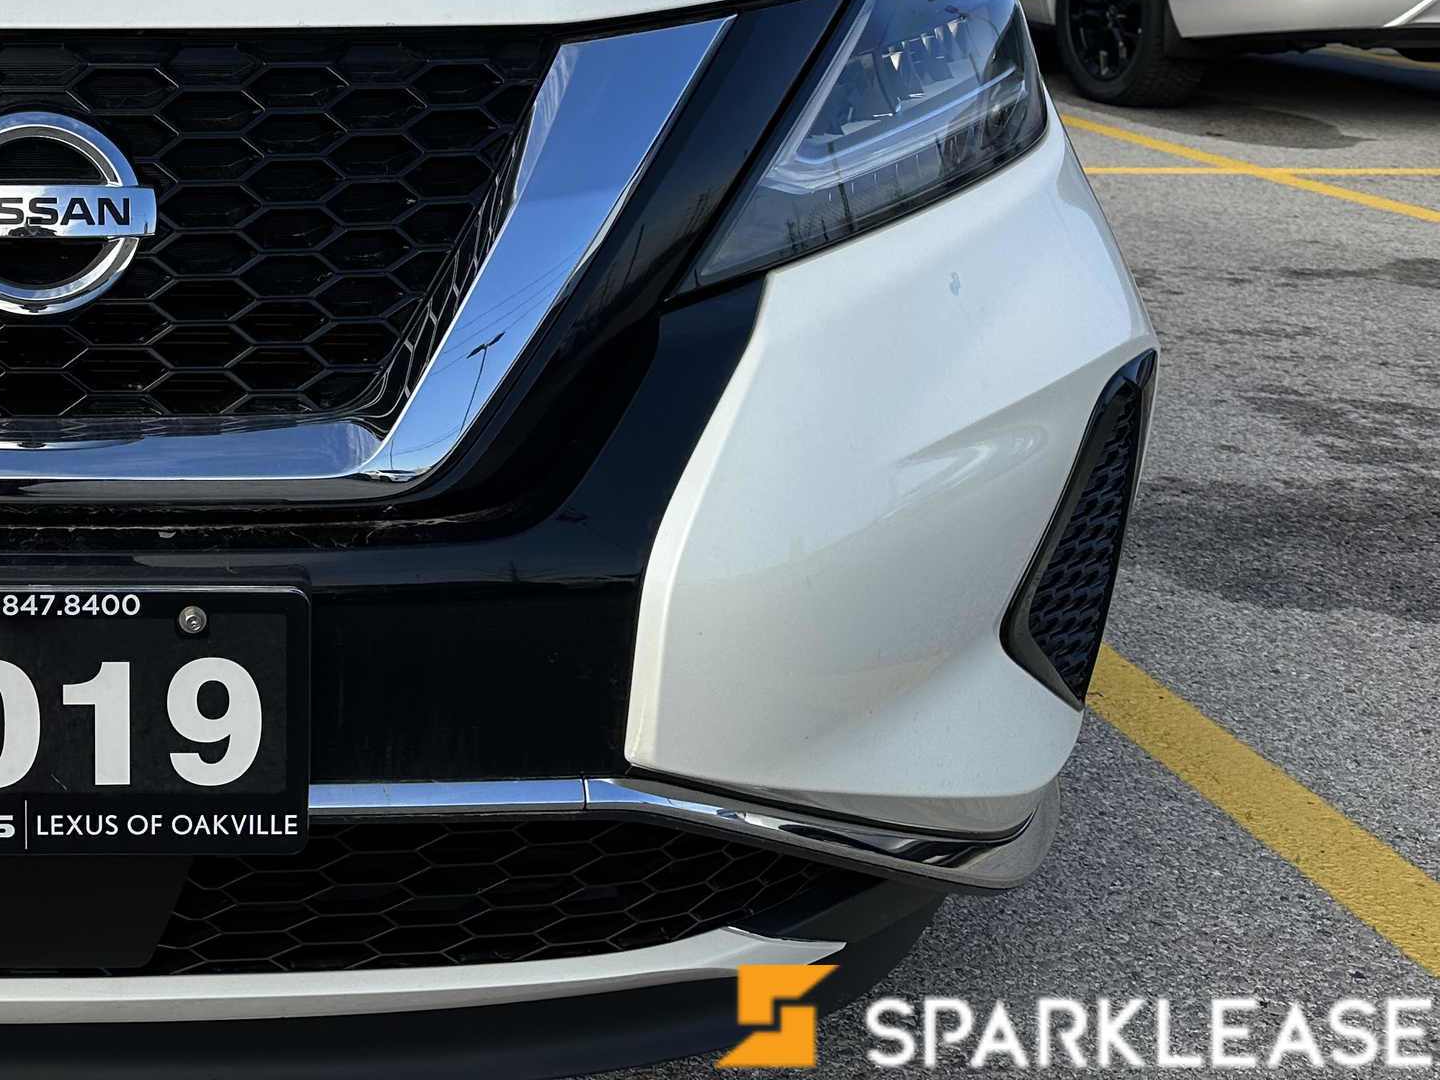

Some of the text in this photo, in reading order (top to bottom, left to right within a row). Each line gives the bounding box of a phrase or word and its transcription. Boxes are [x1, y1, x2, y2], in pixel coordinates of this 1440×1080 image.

[36, 814, 299, 836] LEXUS OF OAKVILLE
